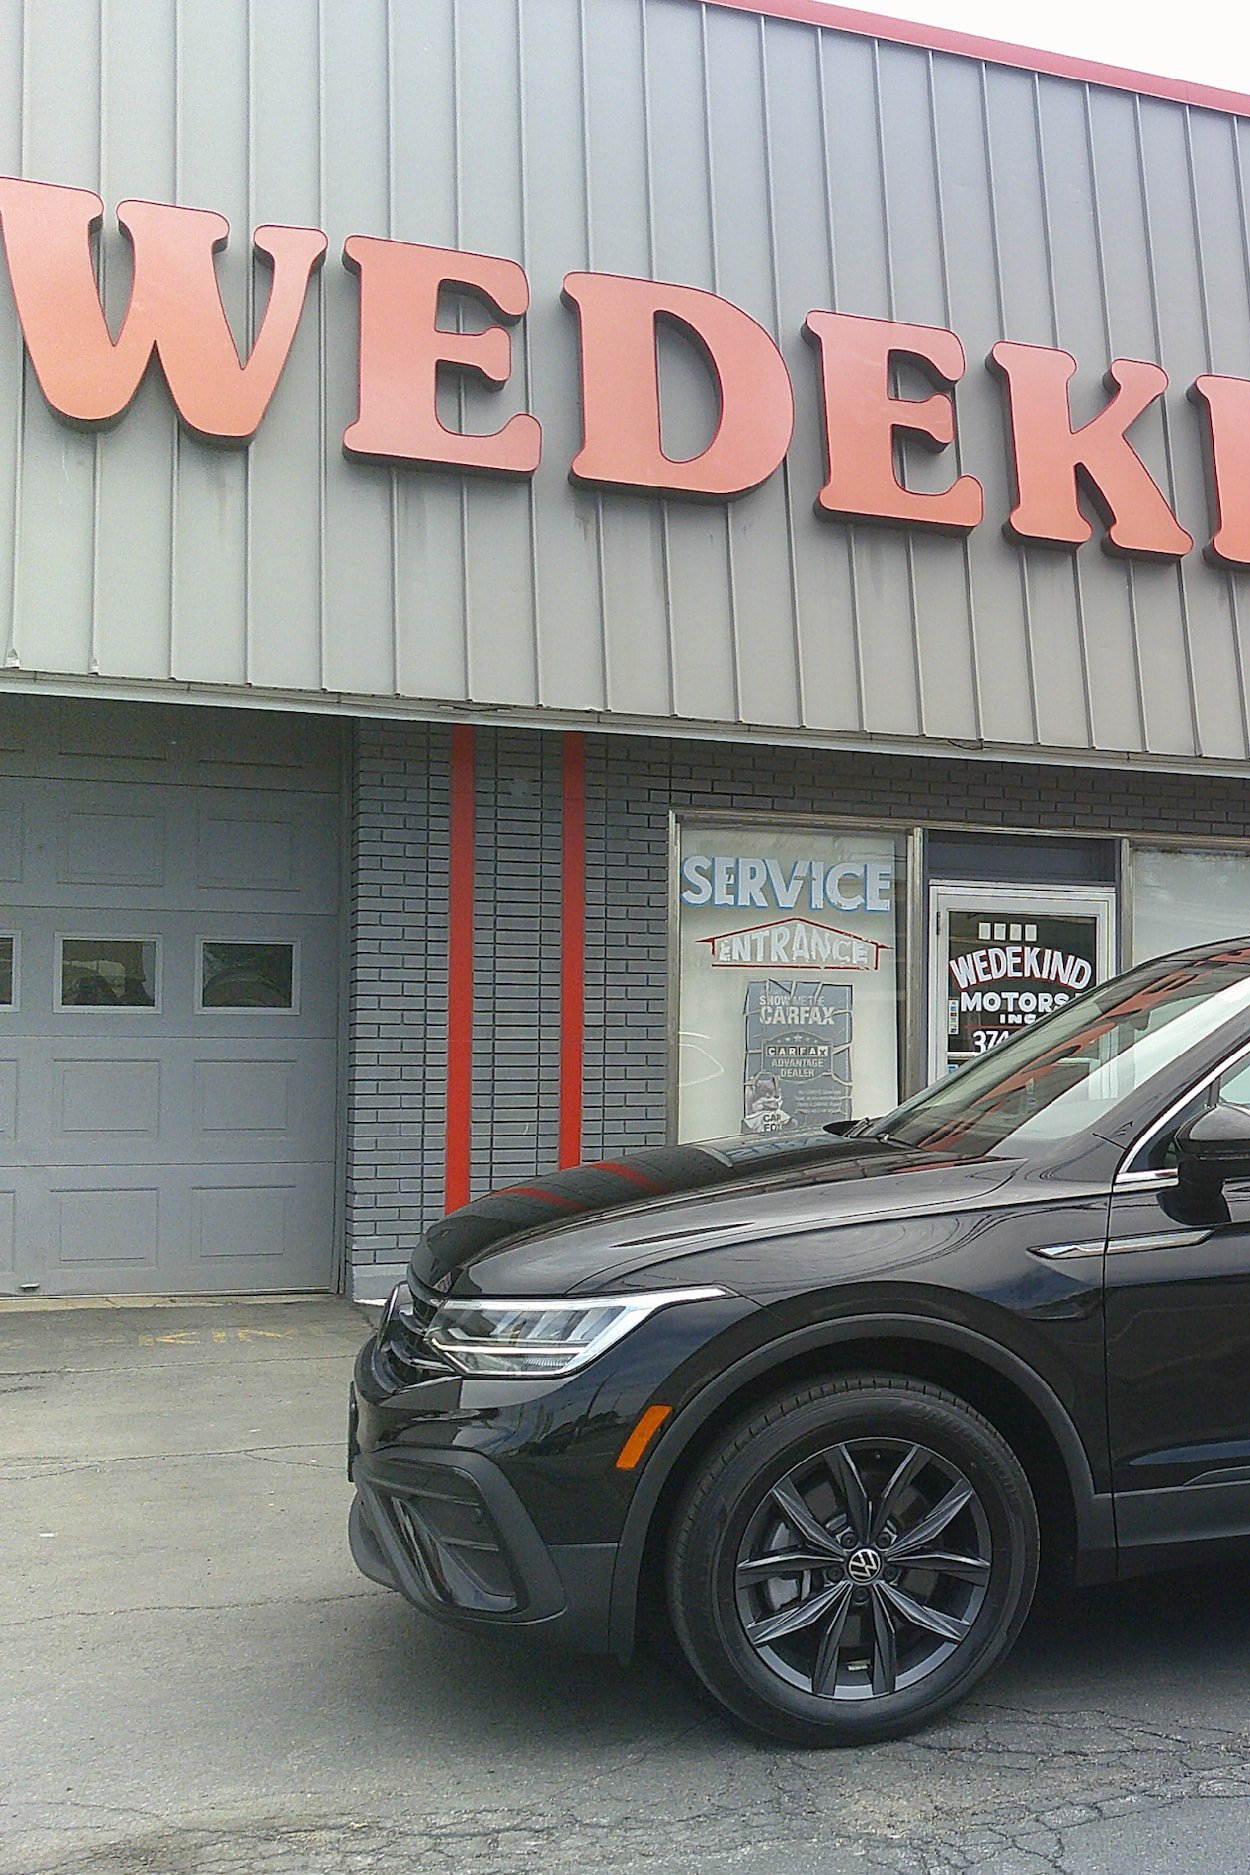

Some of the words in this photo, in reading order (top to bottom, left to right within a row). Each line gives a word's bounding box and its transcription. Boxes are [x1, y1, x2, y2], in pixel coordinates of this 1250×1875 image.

[681, 855, 892, 912] SERVICE
[719, 923, 868, 965] ENTRANCE
[949, 946, 1092, 990] WEDEKIND
[961, 991, 1070, 1013] MOTORS
[760, 1005, 835, 1025] CARFAX
[766, 1045, 829, 1056] CARFAX
[771, 1058, 824, 1068] ADVANTAGE
[780, 1068, 815, 1078] DEALER
